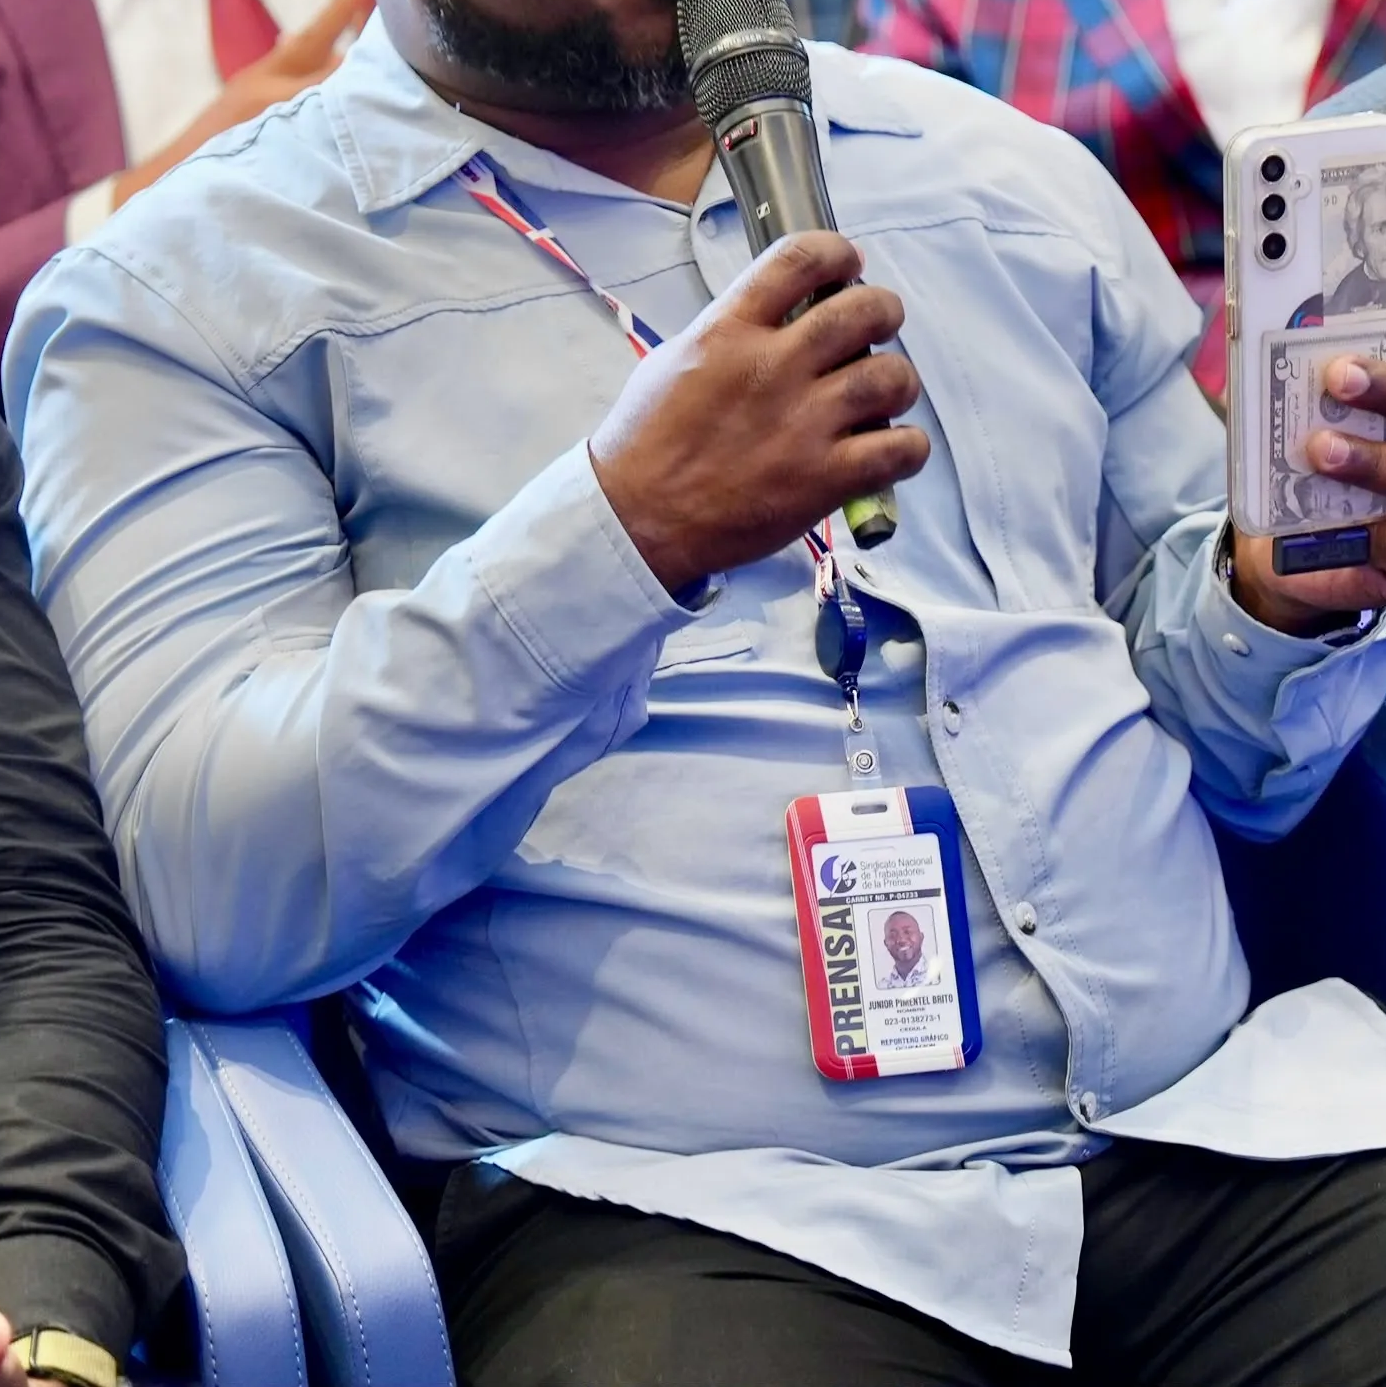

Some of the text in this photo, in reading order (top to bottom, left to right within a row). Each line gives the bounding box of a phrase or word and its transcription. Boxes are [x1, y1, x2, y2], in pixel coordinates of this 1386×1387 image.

[1274, 356, 1300, 381] 5
[1274, 397, 1283, 458] FIVE
[860, 855, 933, 871] Sindicato Nacional
[861, 867, 925, 880] de Trabajadores
[862, 878, 911, 889] de la Prensa
[846, 894, 873, 904] CARNET
[822, 907, 866, 1055] PRENSA
[869, 993, 954, 1010] JUNIOR PIMENTEL BRITO
[881, 1036, 919, 1046] REPORTERO
